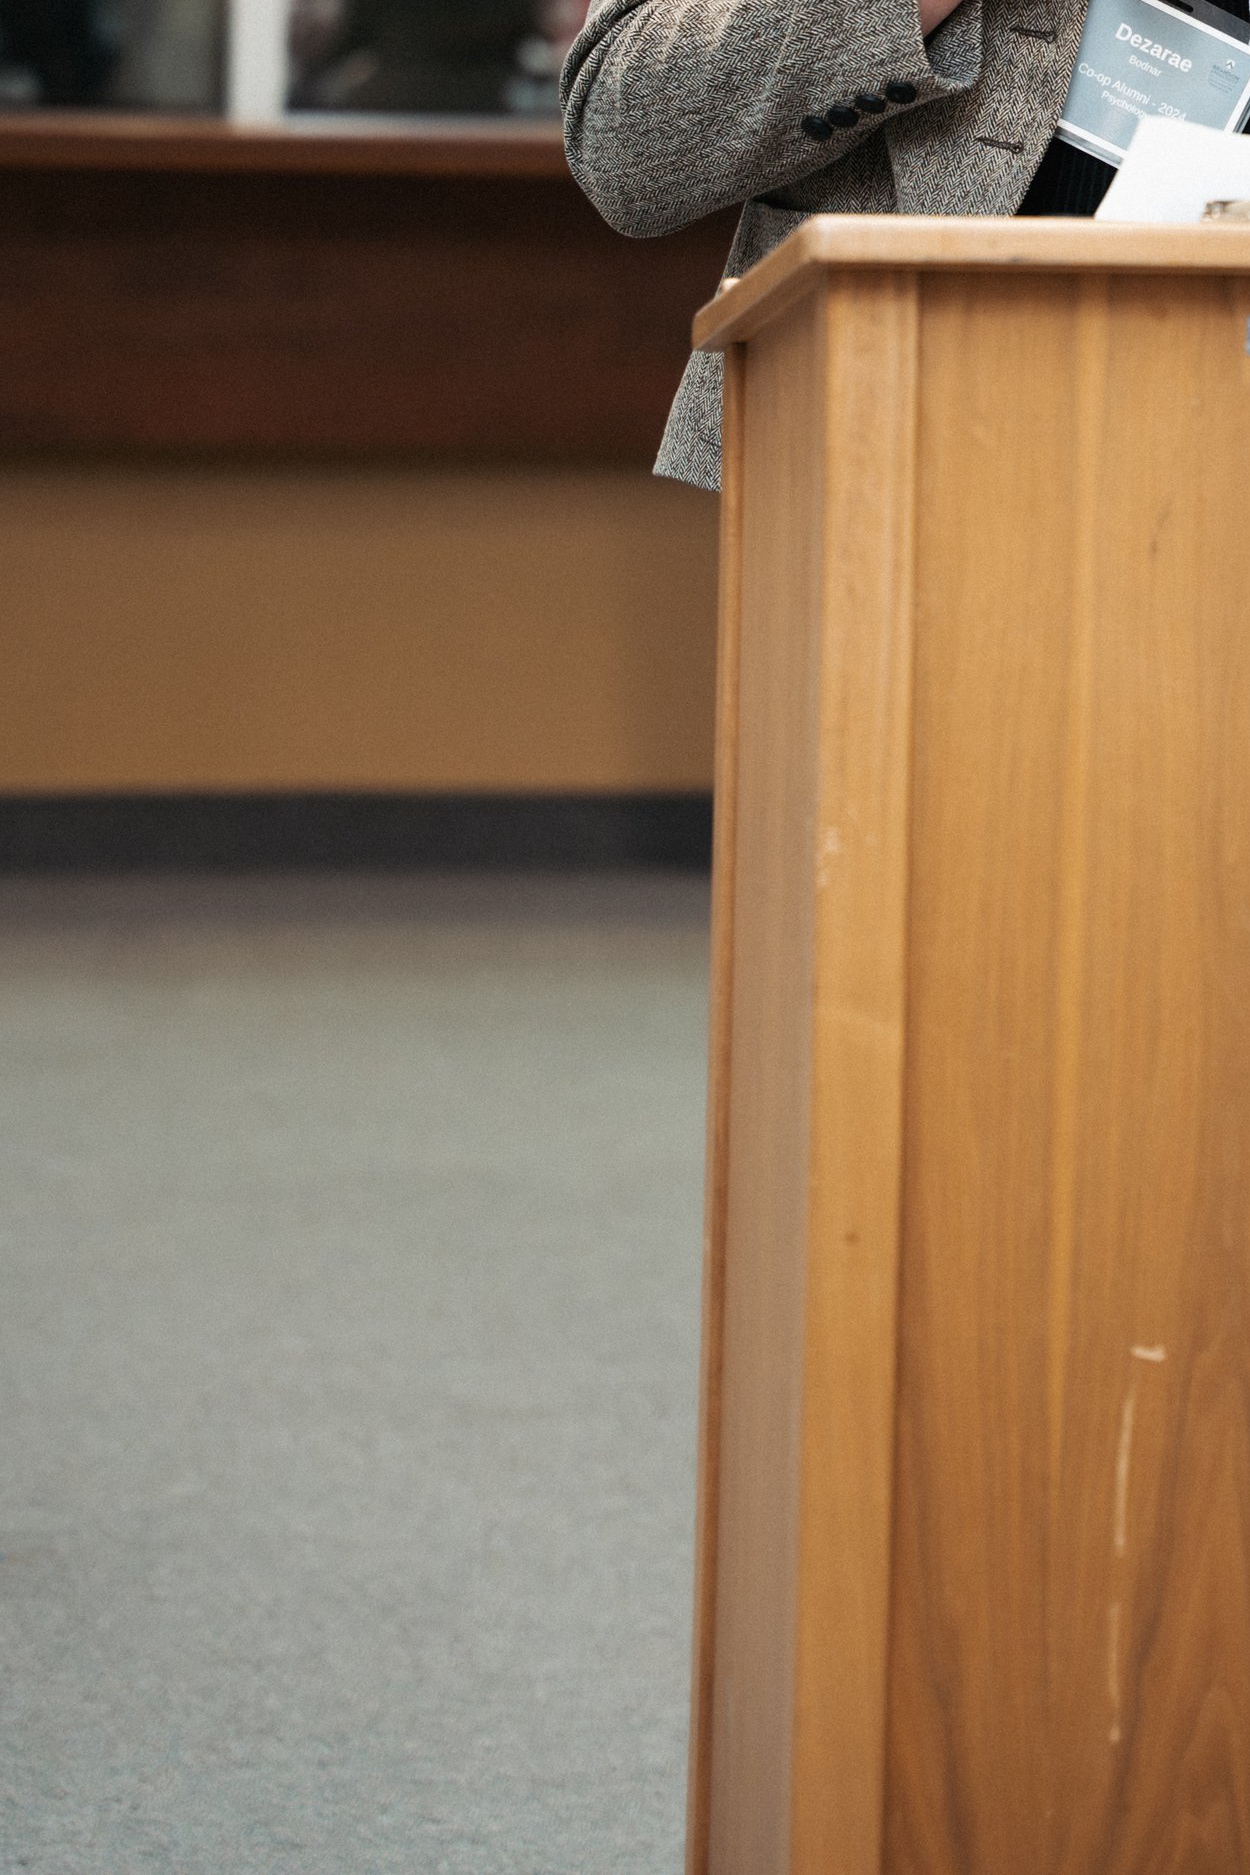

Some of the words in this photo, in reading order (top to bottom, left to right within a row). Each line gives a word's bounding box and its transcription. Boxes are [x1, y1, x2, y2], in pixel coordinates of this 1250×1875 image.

[1115, 22, 1193, 73] Dezarae
[1128, 54, 1163, 78] Bodnar
[1078, 62, 1112, 87] Co-op
[1111, 79, 1152, 106] Alumni
[1157, 101, 1188, 122] 2024
